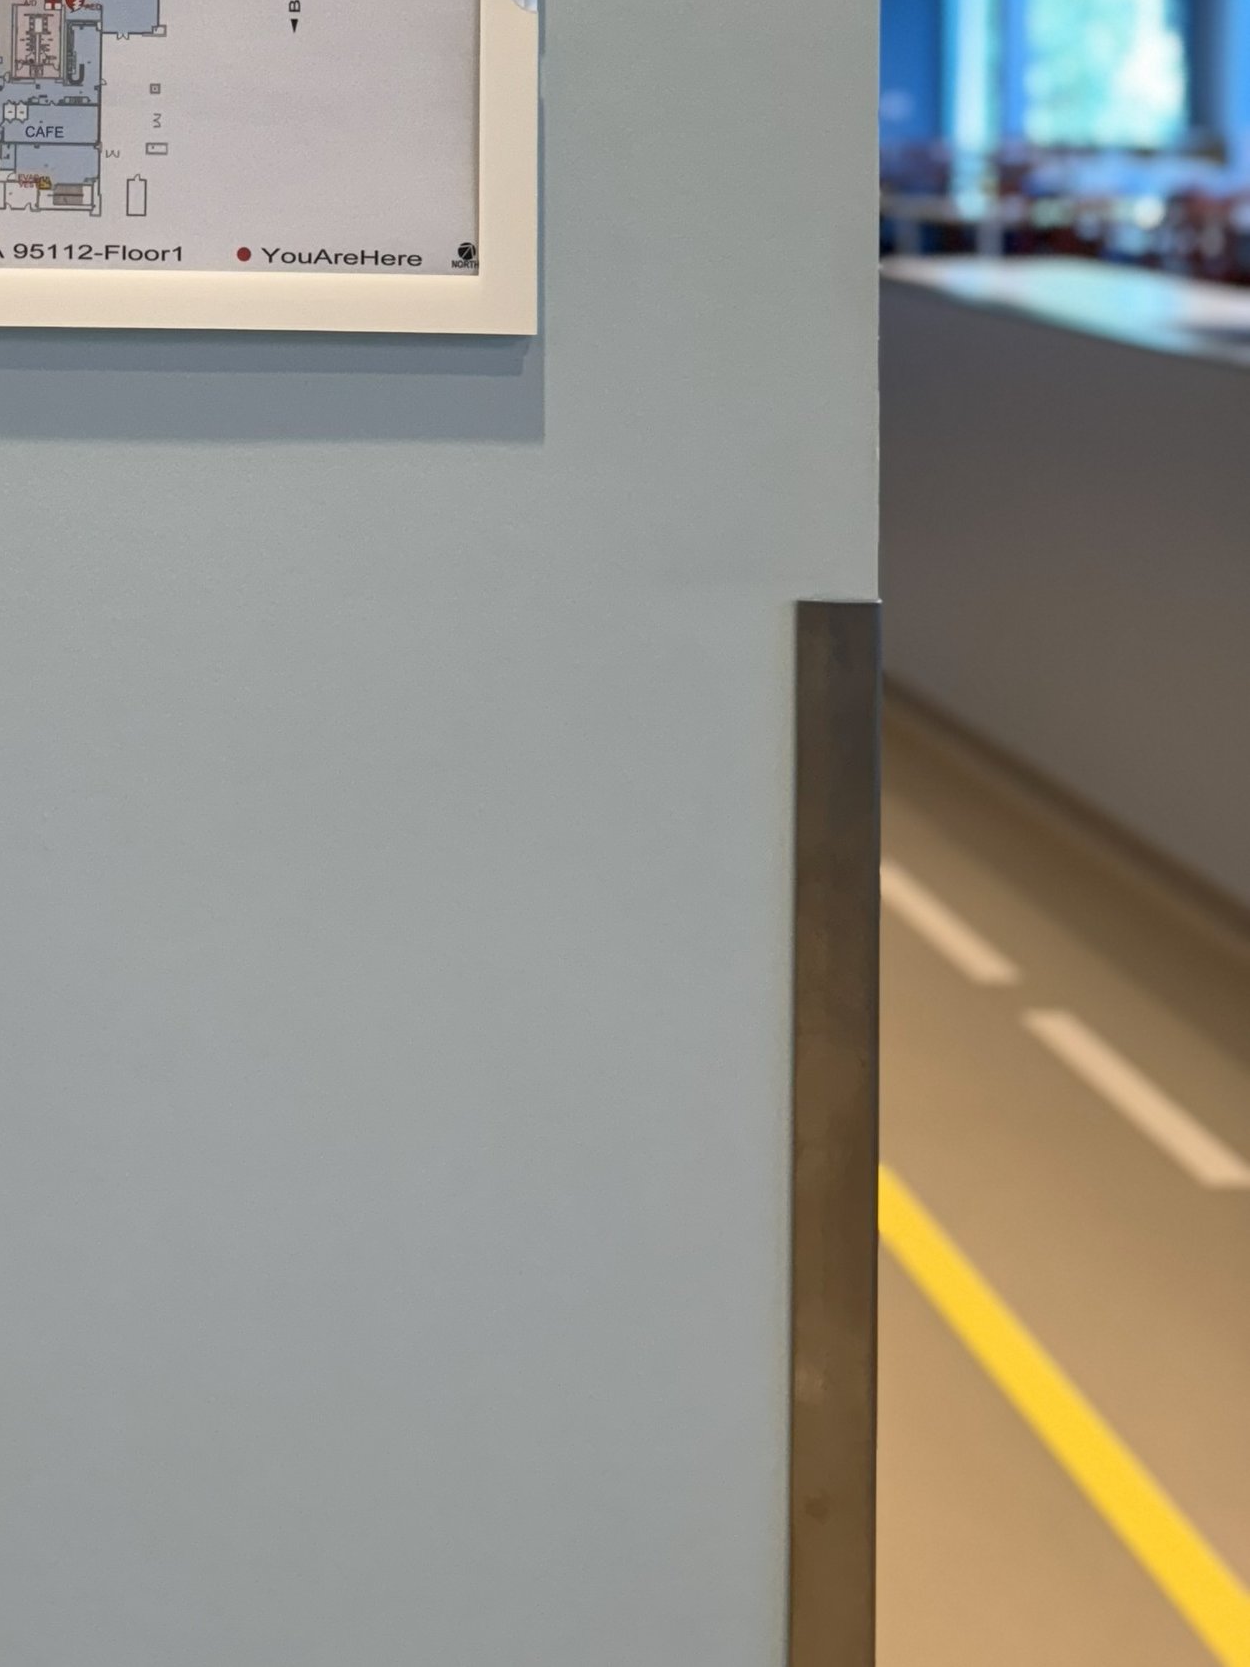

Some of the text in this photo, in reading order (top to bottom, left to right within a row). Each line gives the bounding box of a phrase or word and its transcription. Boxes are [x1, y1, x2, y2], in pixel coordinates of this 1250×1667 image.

[25, 125, 64, 139] CAFE
[13, 243, 183, 262] 95112-Floor1
[261, 247, 423, 267] YouAreHere
[451, 259, 479, 269] NORTH
